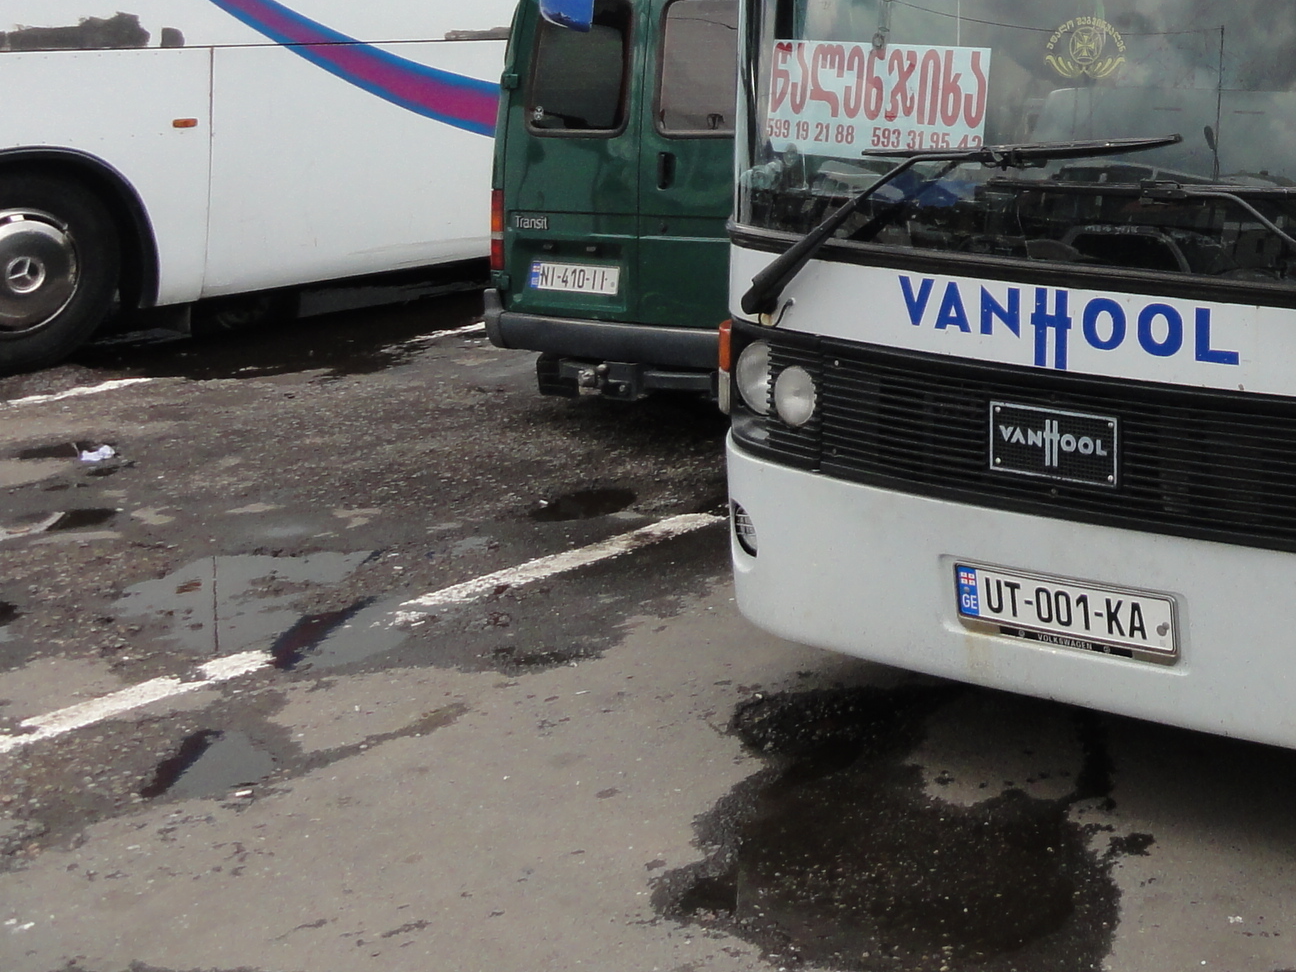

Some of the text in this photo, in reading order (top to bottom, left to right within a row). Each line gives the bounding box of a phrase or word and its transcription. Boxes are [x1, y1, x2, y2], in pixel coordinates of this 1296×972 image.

[770, 42, 987, 128] წალენჯიხა
[766, 118, 791, 139] 599
[795, 120, 809, 141] 19
[814, 122, 830, 142] 21
[835, 123, 855, 144] 88
[871, 127, 901, 148] 593
[906, 130, 924, 150] 31
[929, 131, 951, 150] 95
[515, 215, 548, 230] Transit
[962, 593, 978, 610] GE
[985, 577, 1148, 640] UT-001-KA
[1037, 633, 1093, 650] VOLKSWAGEN
